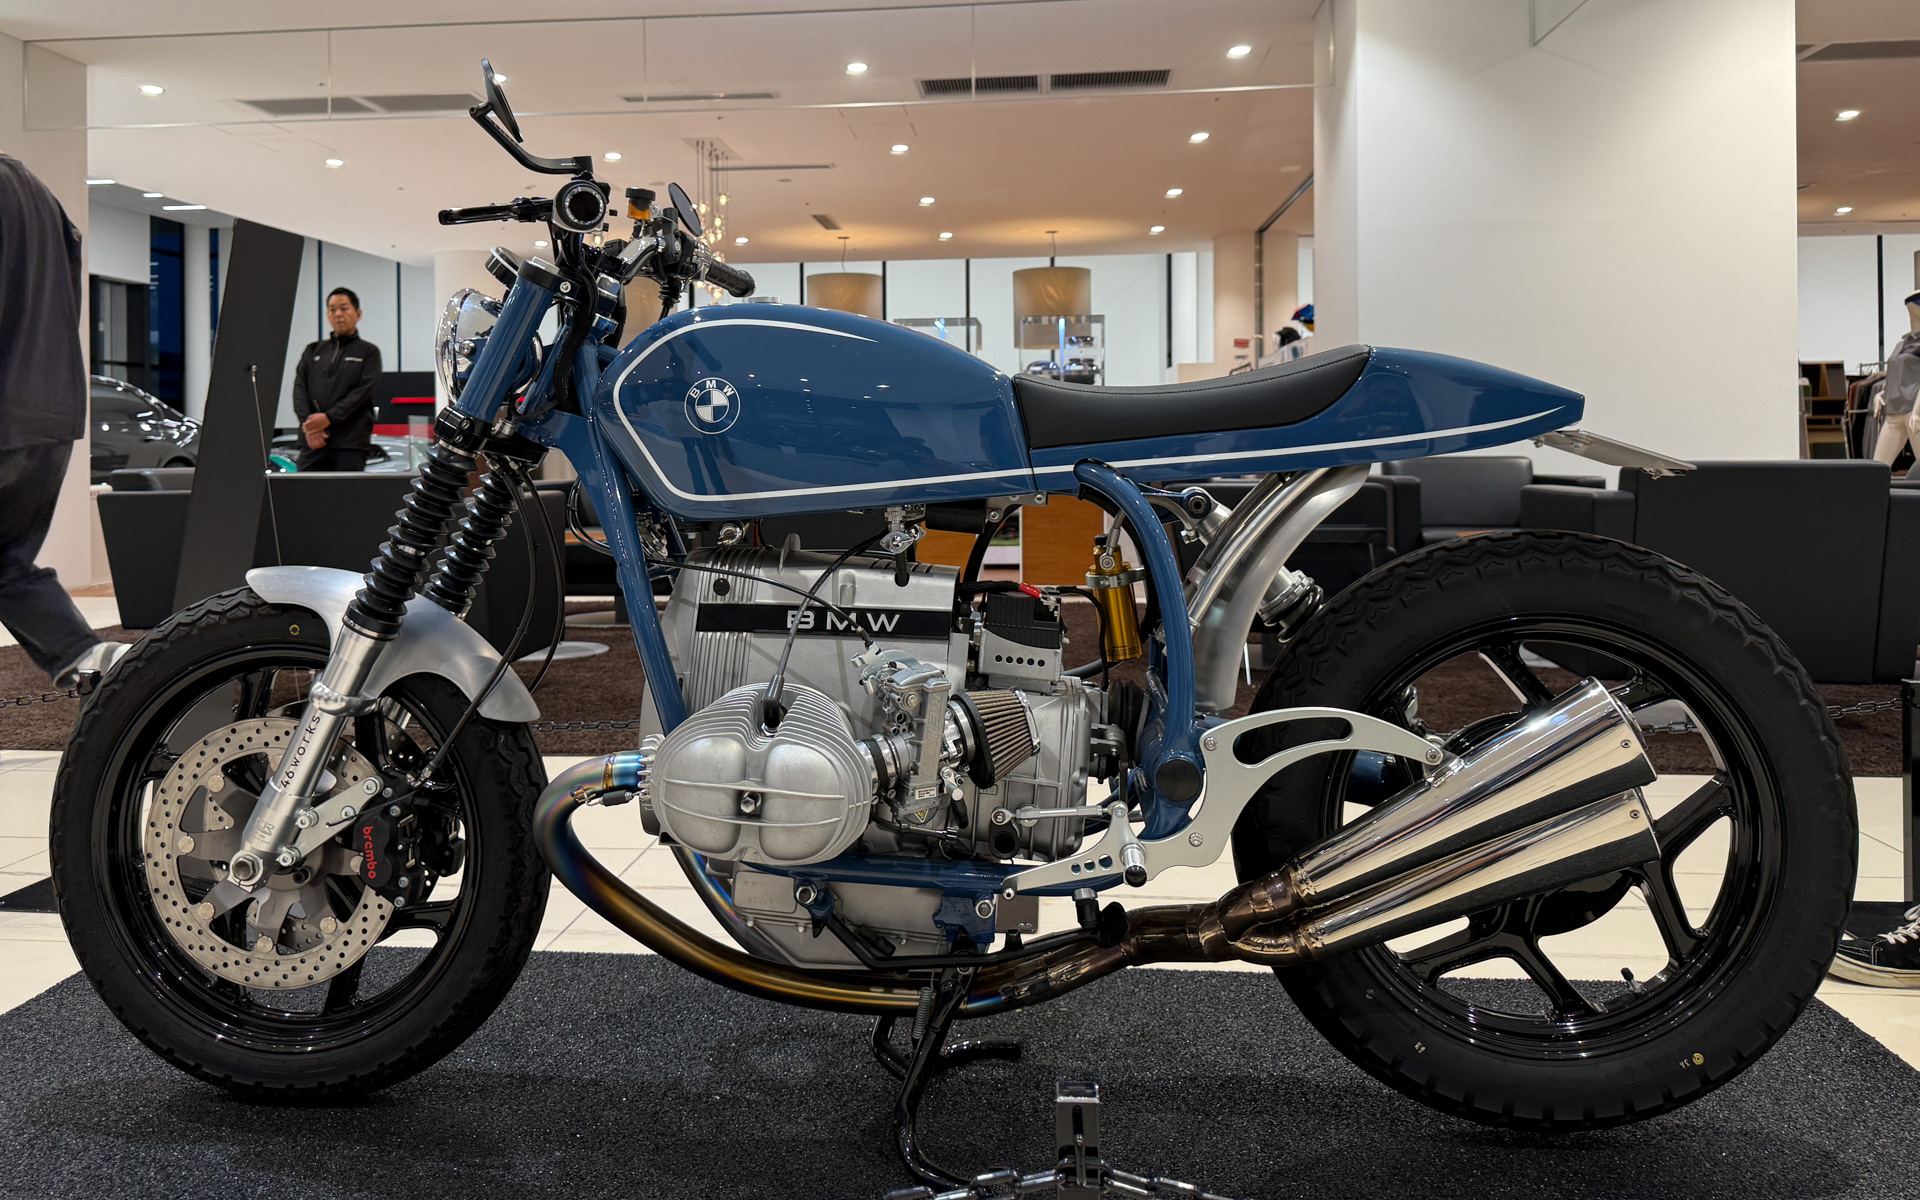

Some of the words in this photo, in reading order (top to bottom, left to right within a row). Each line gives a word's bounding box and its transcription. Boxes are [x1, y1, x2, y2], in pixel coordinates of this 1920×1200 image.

[689, 379, 735, 399] BMW
[786, 609, 901, 633] BMW
[280, 715, 321, 788] 46works
[362, 826, 378, 879] brembo
